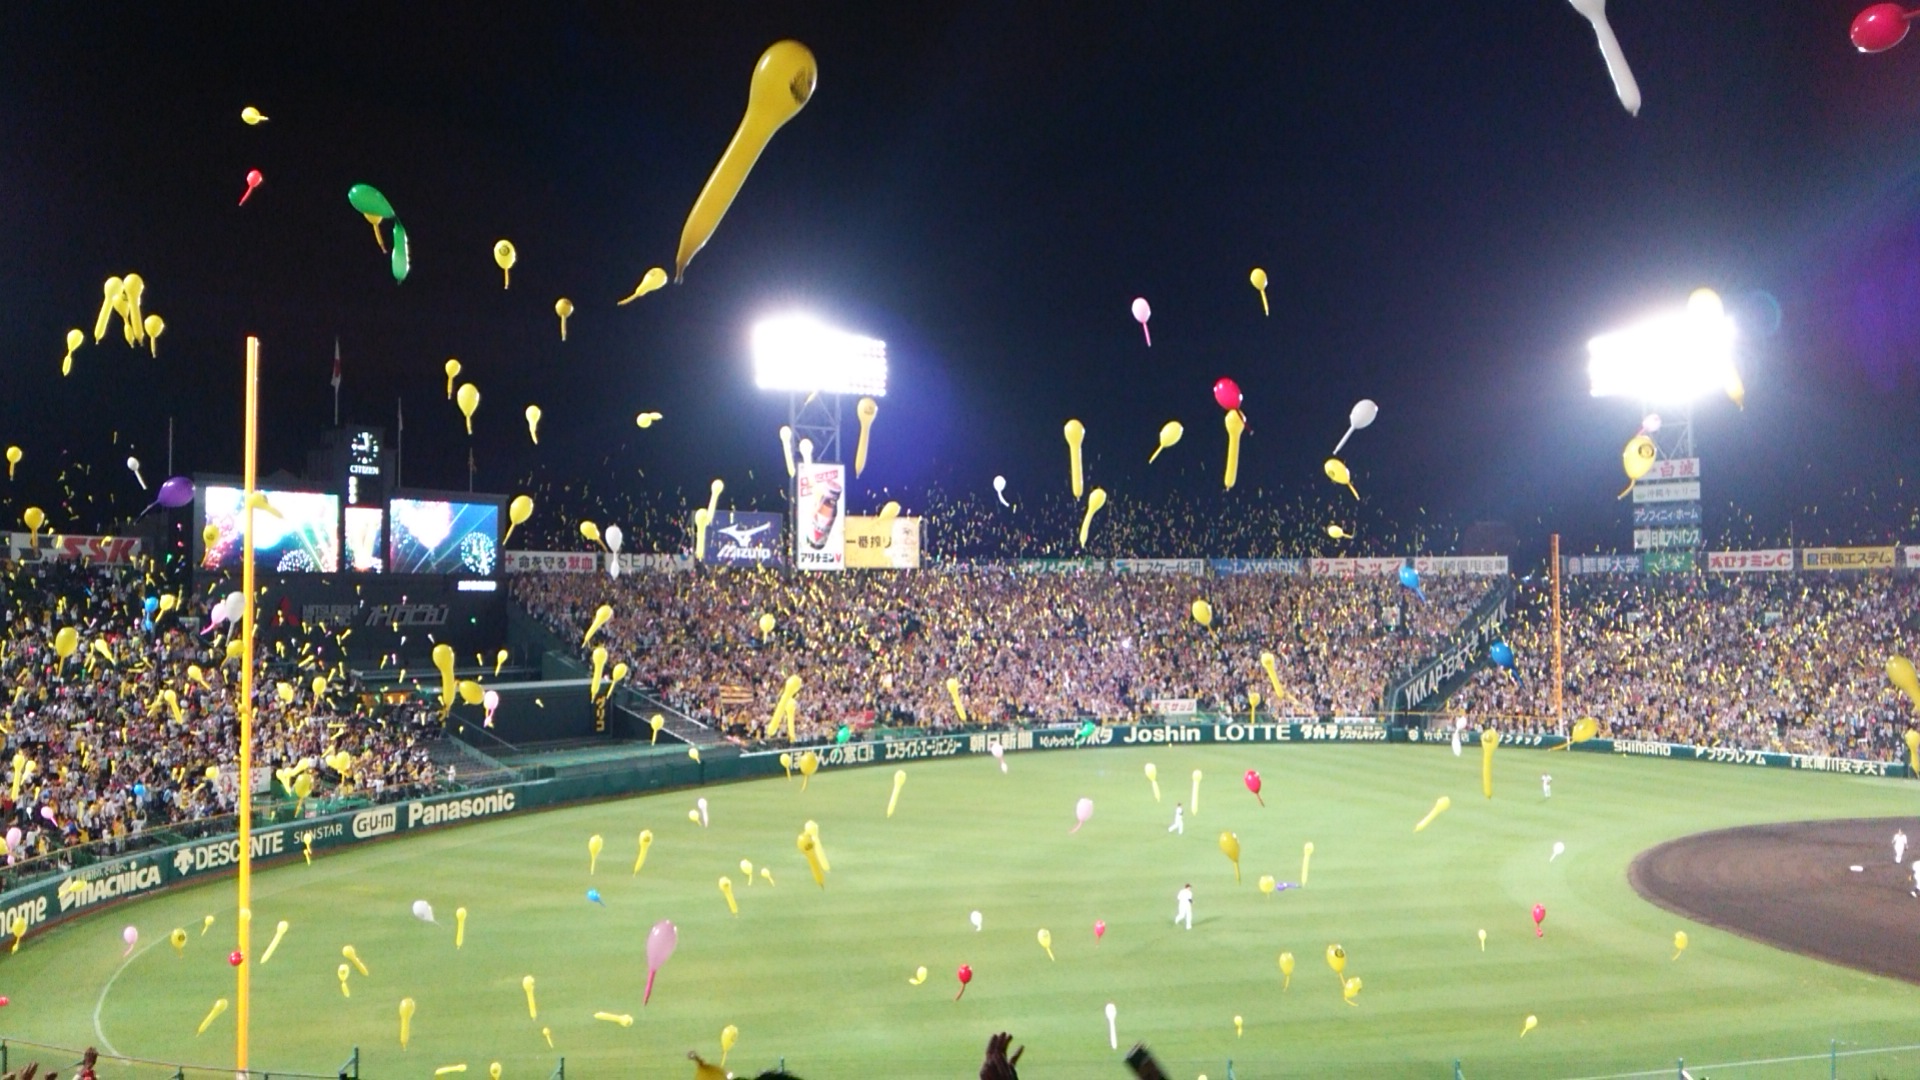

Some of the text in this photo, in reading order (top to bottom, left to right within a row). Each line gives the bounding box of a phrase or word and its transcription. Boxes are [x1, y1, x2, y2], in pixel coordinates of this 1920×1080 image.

[349, 464, 379, 475] CITIZEN
[1660, 461, 1695, 477] 白波
[60, 537, 138, 562] SSK
[846, 536, 892, 549] 一番搾り
[518, 555, 593, 571] 命を守る献血
[1233, 560, 1300, 574] LAWSON
[1710, 553, 1791, 568] オロナミンC
[1124, 725, 1201, 742] Joshin
[1214, 724, 1292, 741] LOTTE
[1299, 725, 1338, 739] タカラ
[1423, 730, 1470, 743] 竹中工店
[969, 730, 1034, 753] 朝日新聞
[1613, 741, 1672, 757] SHIMANO
[789, 744, 869, 770] ほんの窓口
[1707, 749, 1767, 765] フジプレアム
[1801, 758, 1878, 775] 武庫川女子大
[408, 789, 516, 829] Panasonic
[196, 831, 285, 871] DESCNTE
